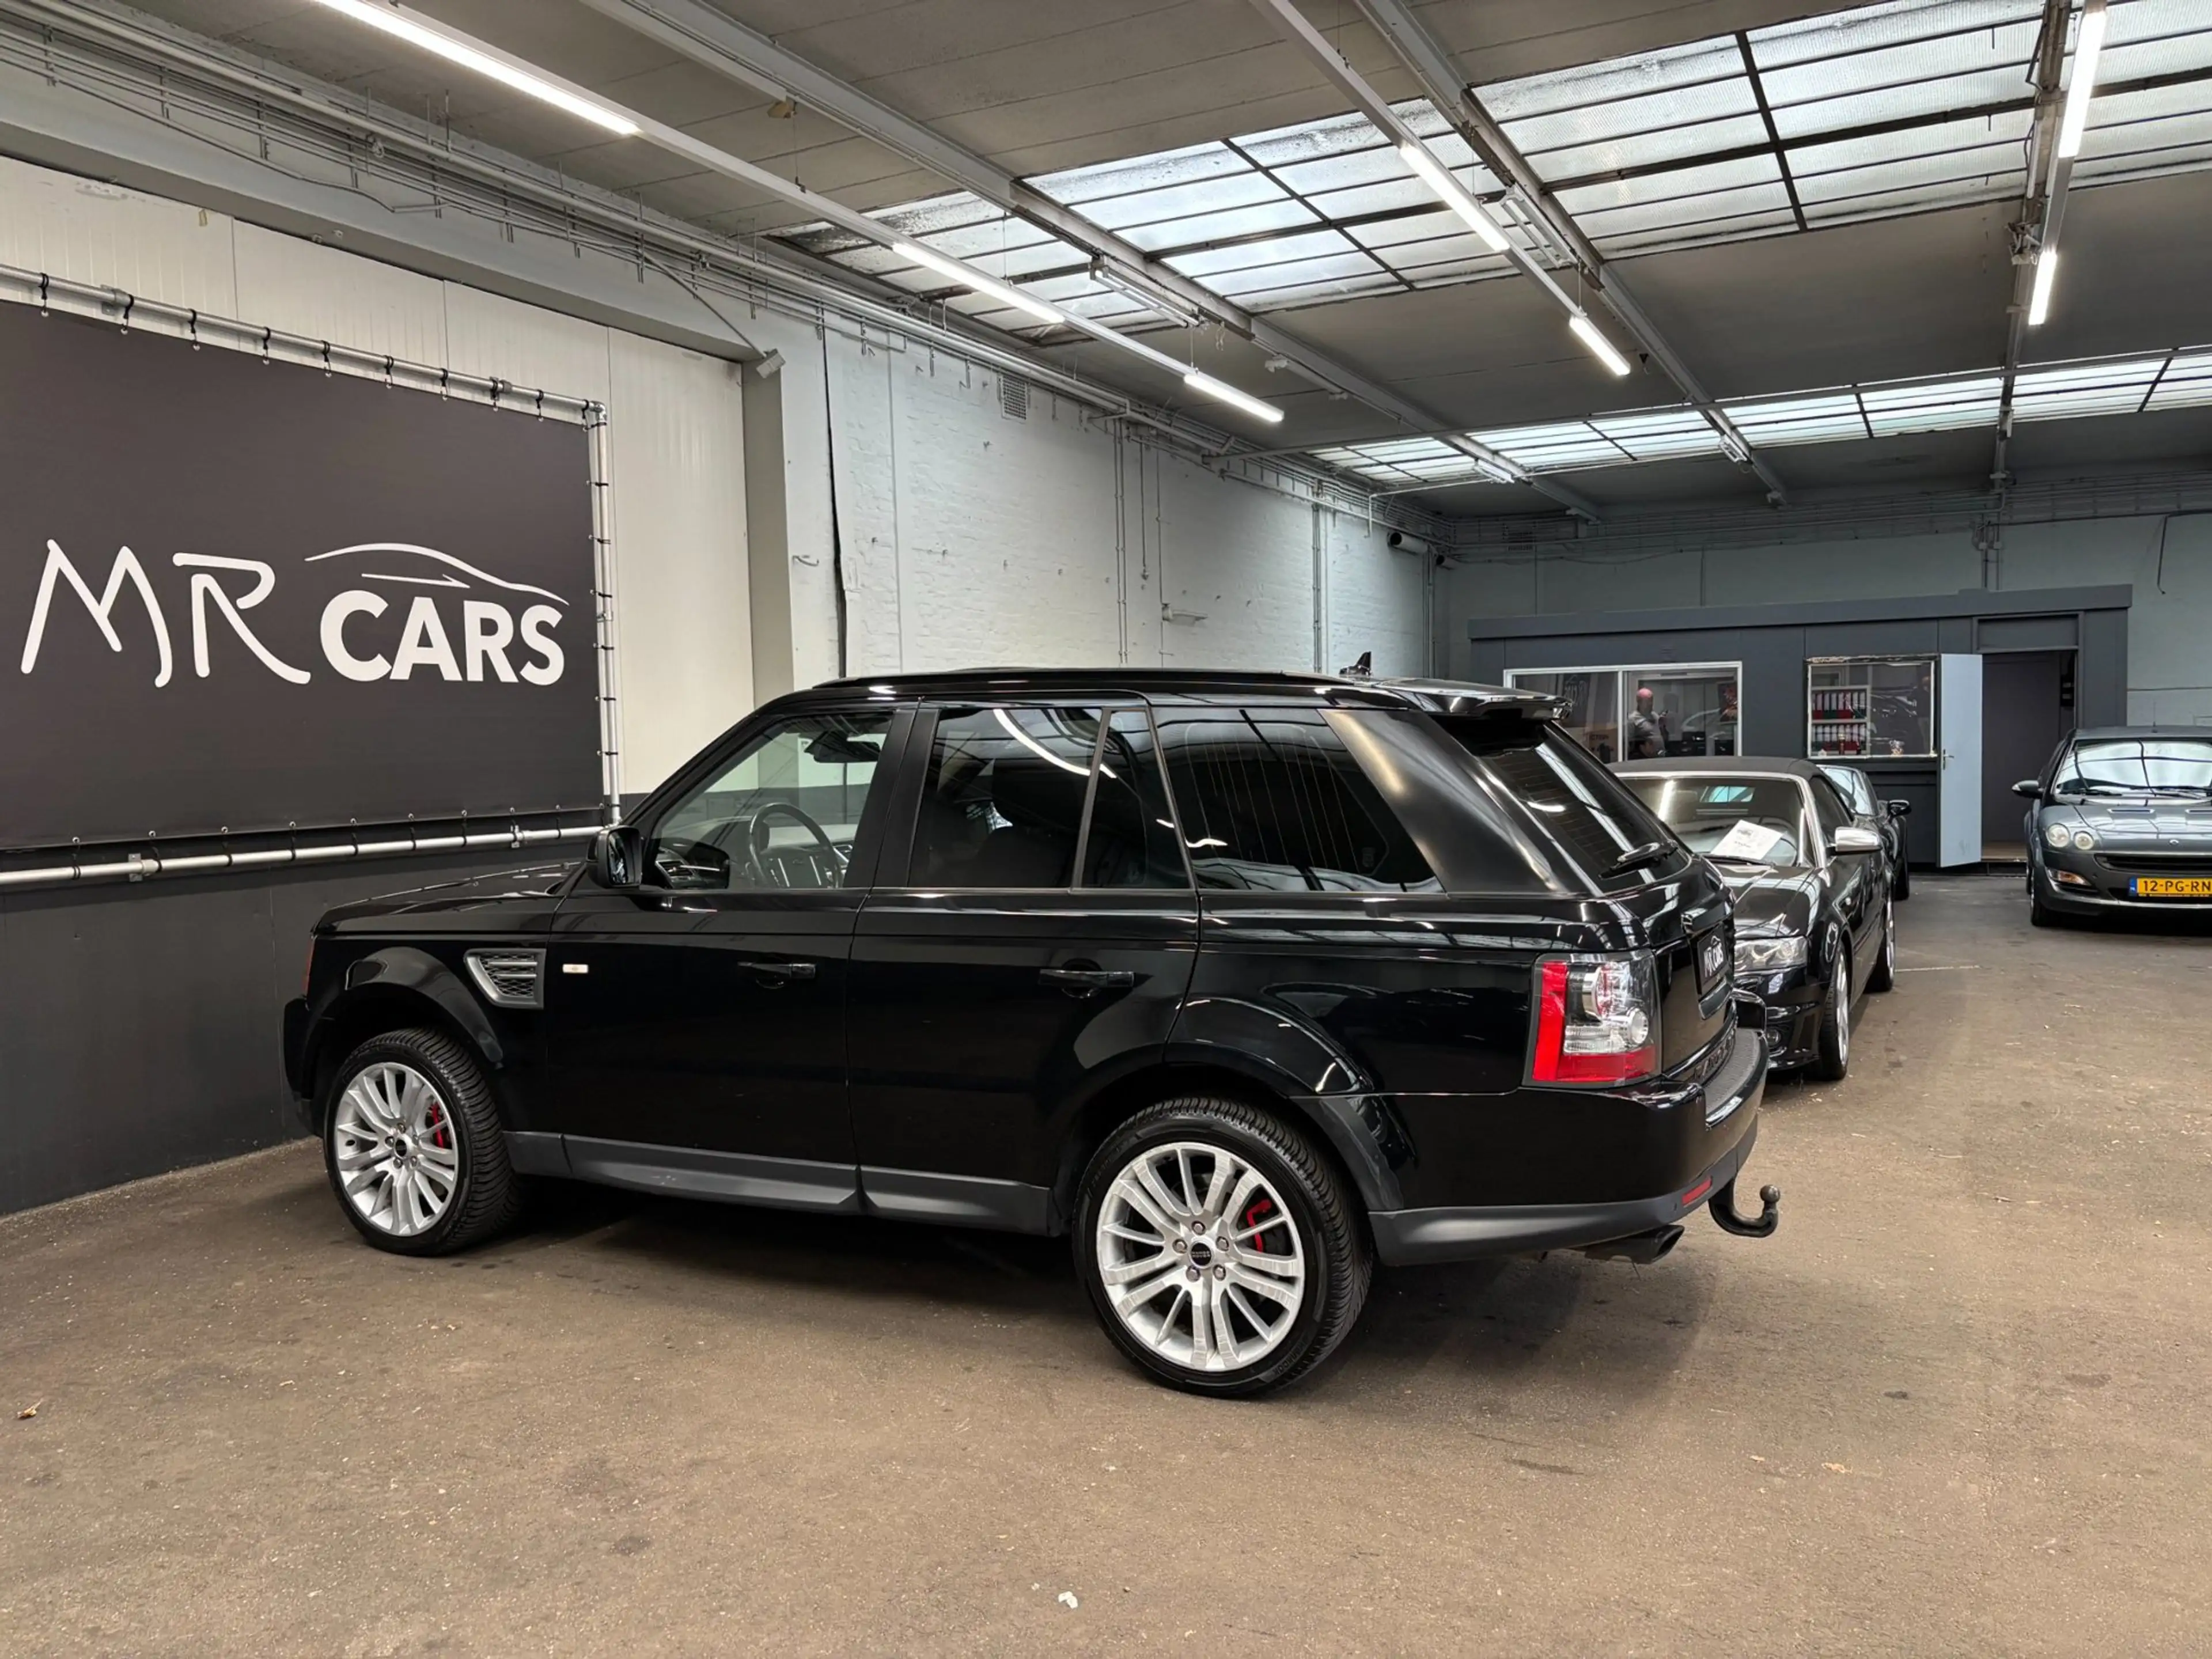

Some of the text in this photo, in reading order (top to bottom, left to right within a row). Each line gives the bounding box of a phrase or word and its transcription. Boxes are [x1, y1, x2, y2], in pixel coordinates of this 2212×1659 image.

[21, 539, 564, 687] MR CARS
[2143, 880, 2211, 892] 12-PG-RN
